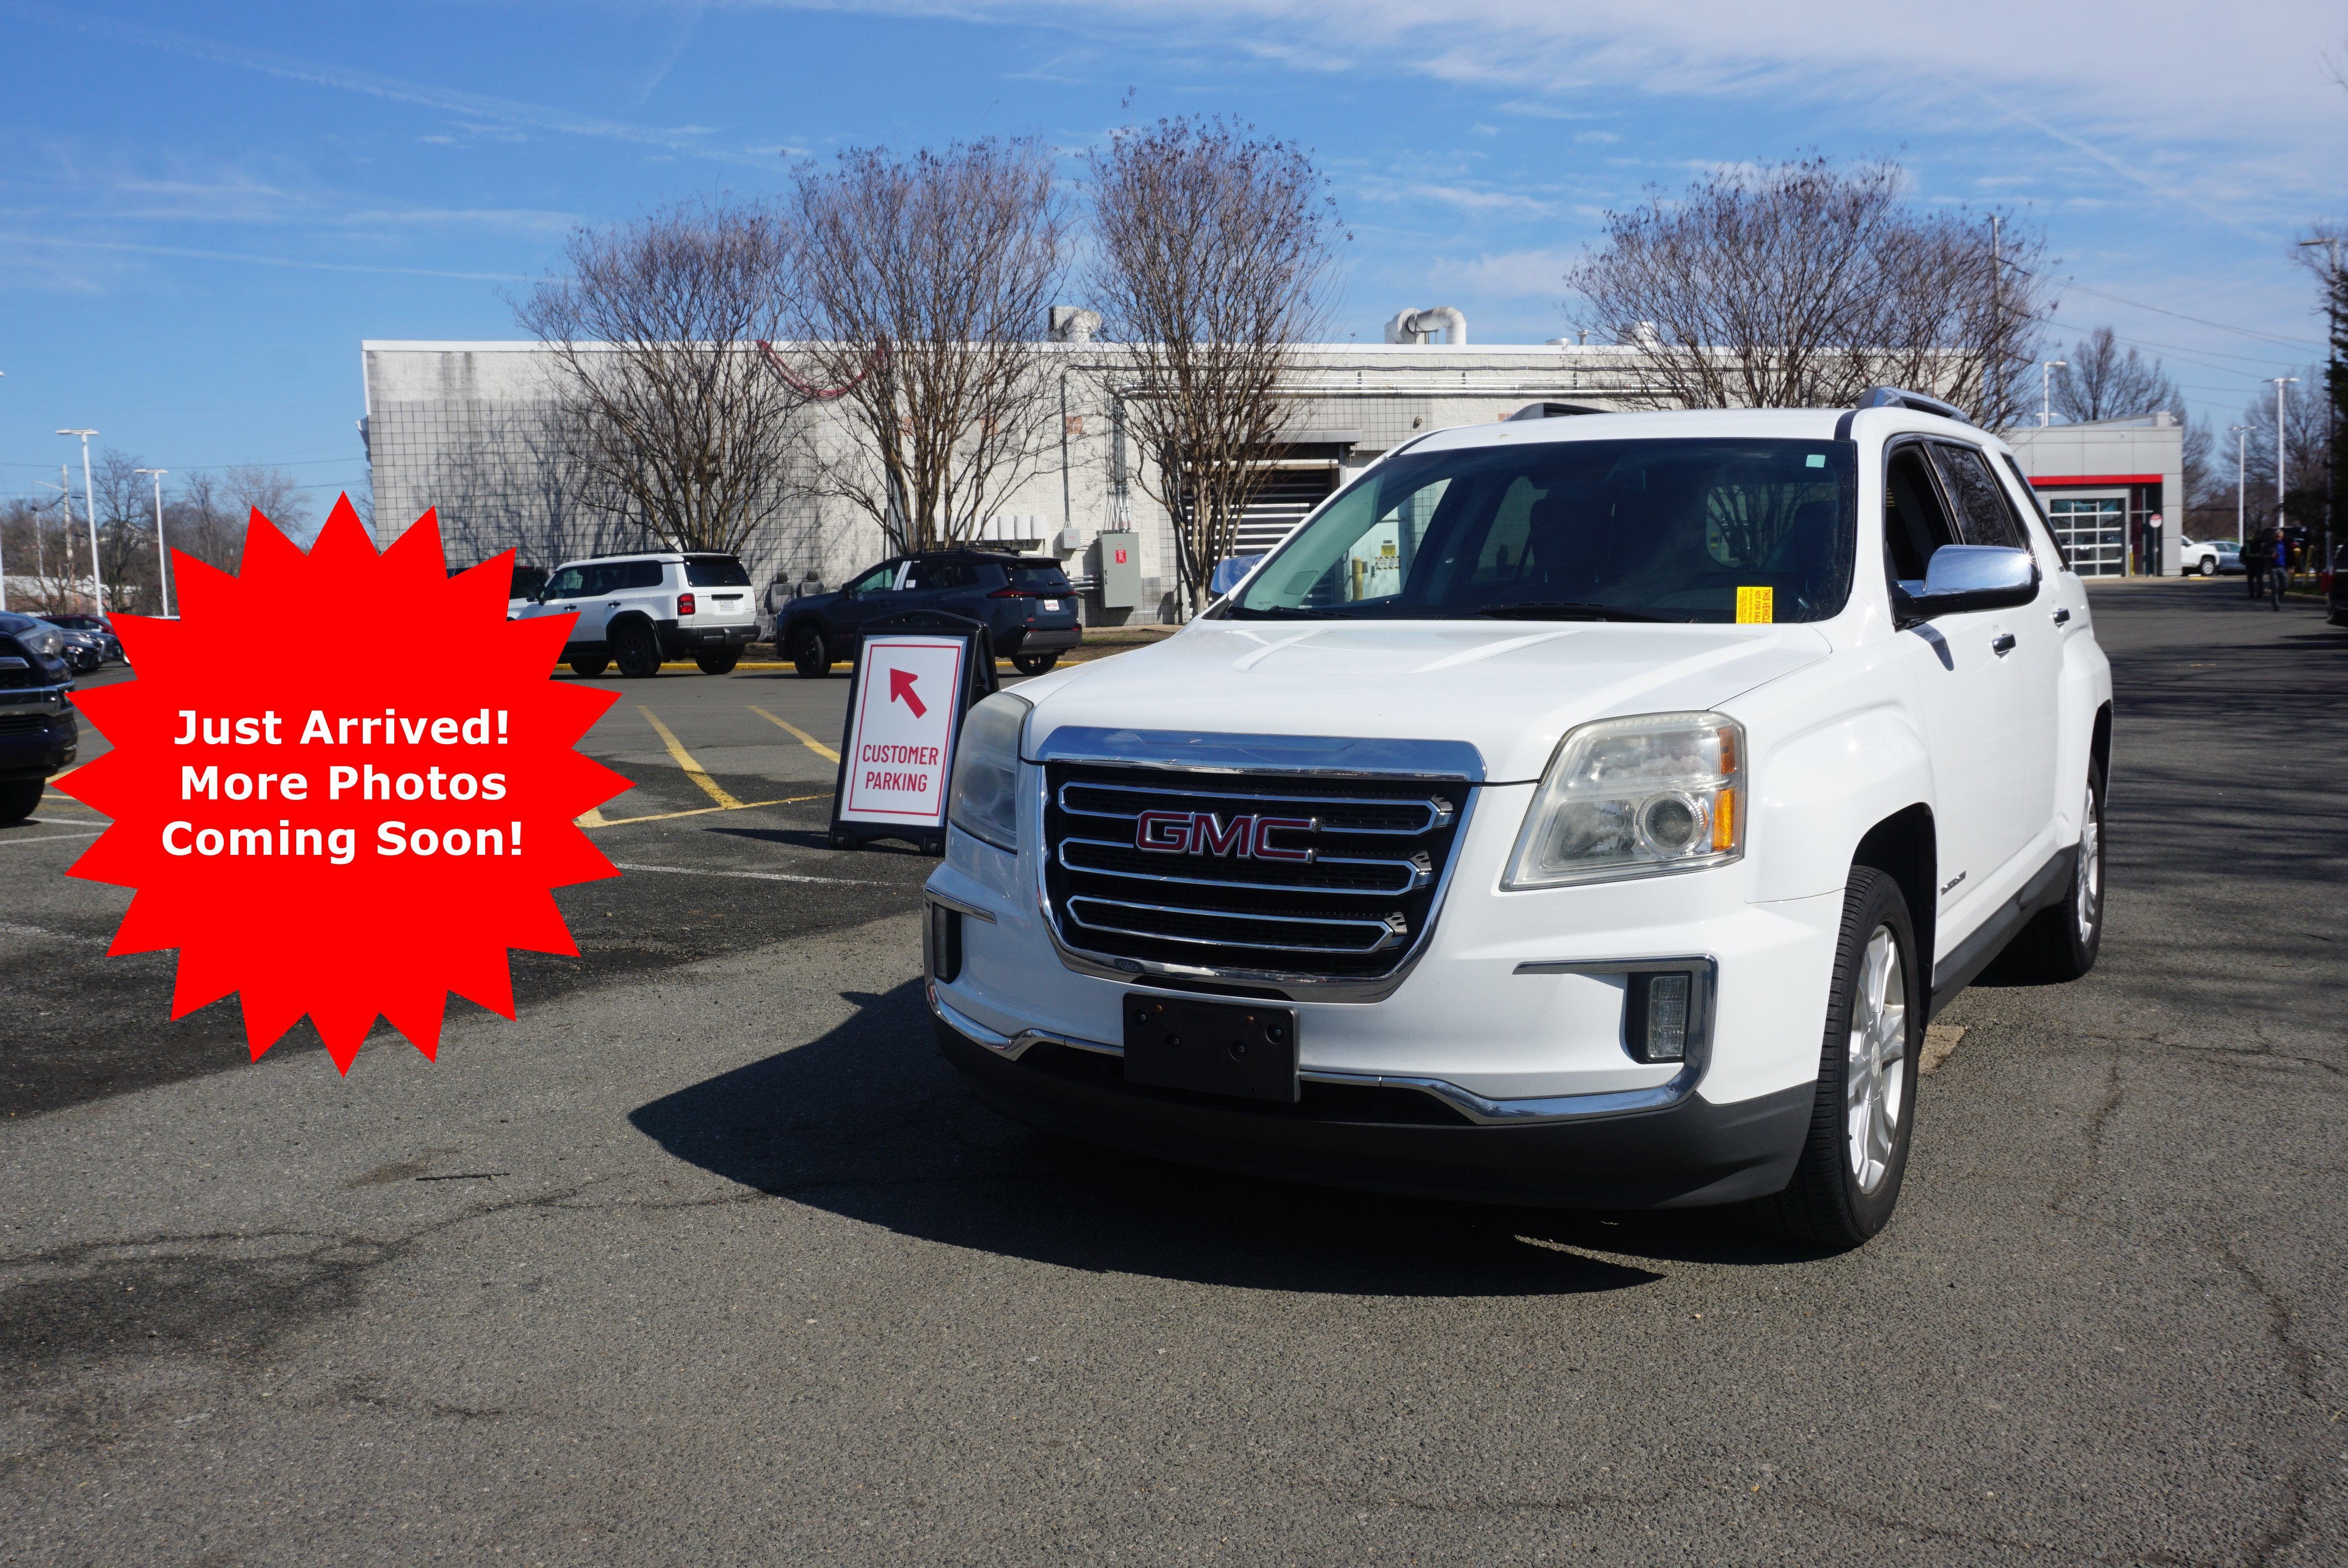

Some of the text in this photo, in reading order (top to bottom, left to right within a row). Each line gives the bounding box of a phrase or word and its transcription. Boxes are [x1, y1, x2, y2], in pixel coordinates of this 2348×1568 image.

[863, 744, 939, 765] CUSTOMER
[866, 771, 928, 792] PARKING
[1136, 809, 1318, 864] GMC
